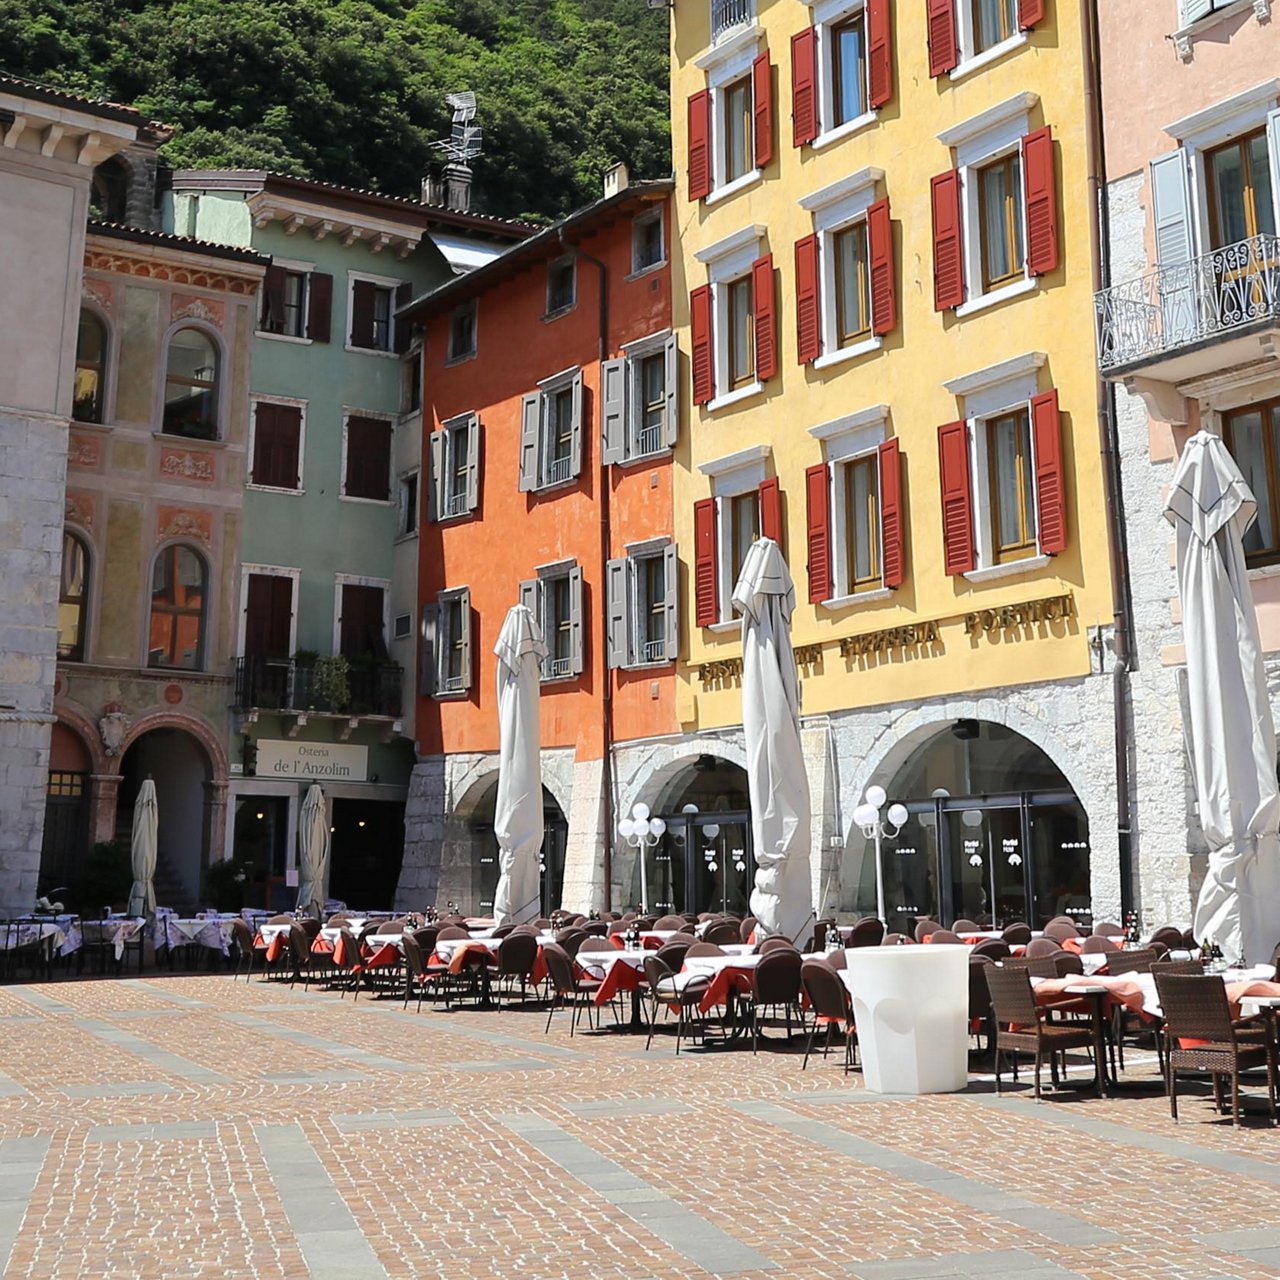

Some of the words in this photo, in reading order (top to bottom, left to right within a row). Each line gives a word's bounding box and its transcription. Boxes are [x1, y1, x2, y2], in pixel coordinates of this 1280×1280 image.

[840, 620, 943, 657] PIZZERIA
[964, 594, 1073, 634] PORTICI
[298, 746, 329, 757] Osteria
[274, 759, 289, 773] de
